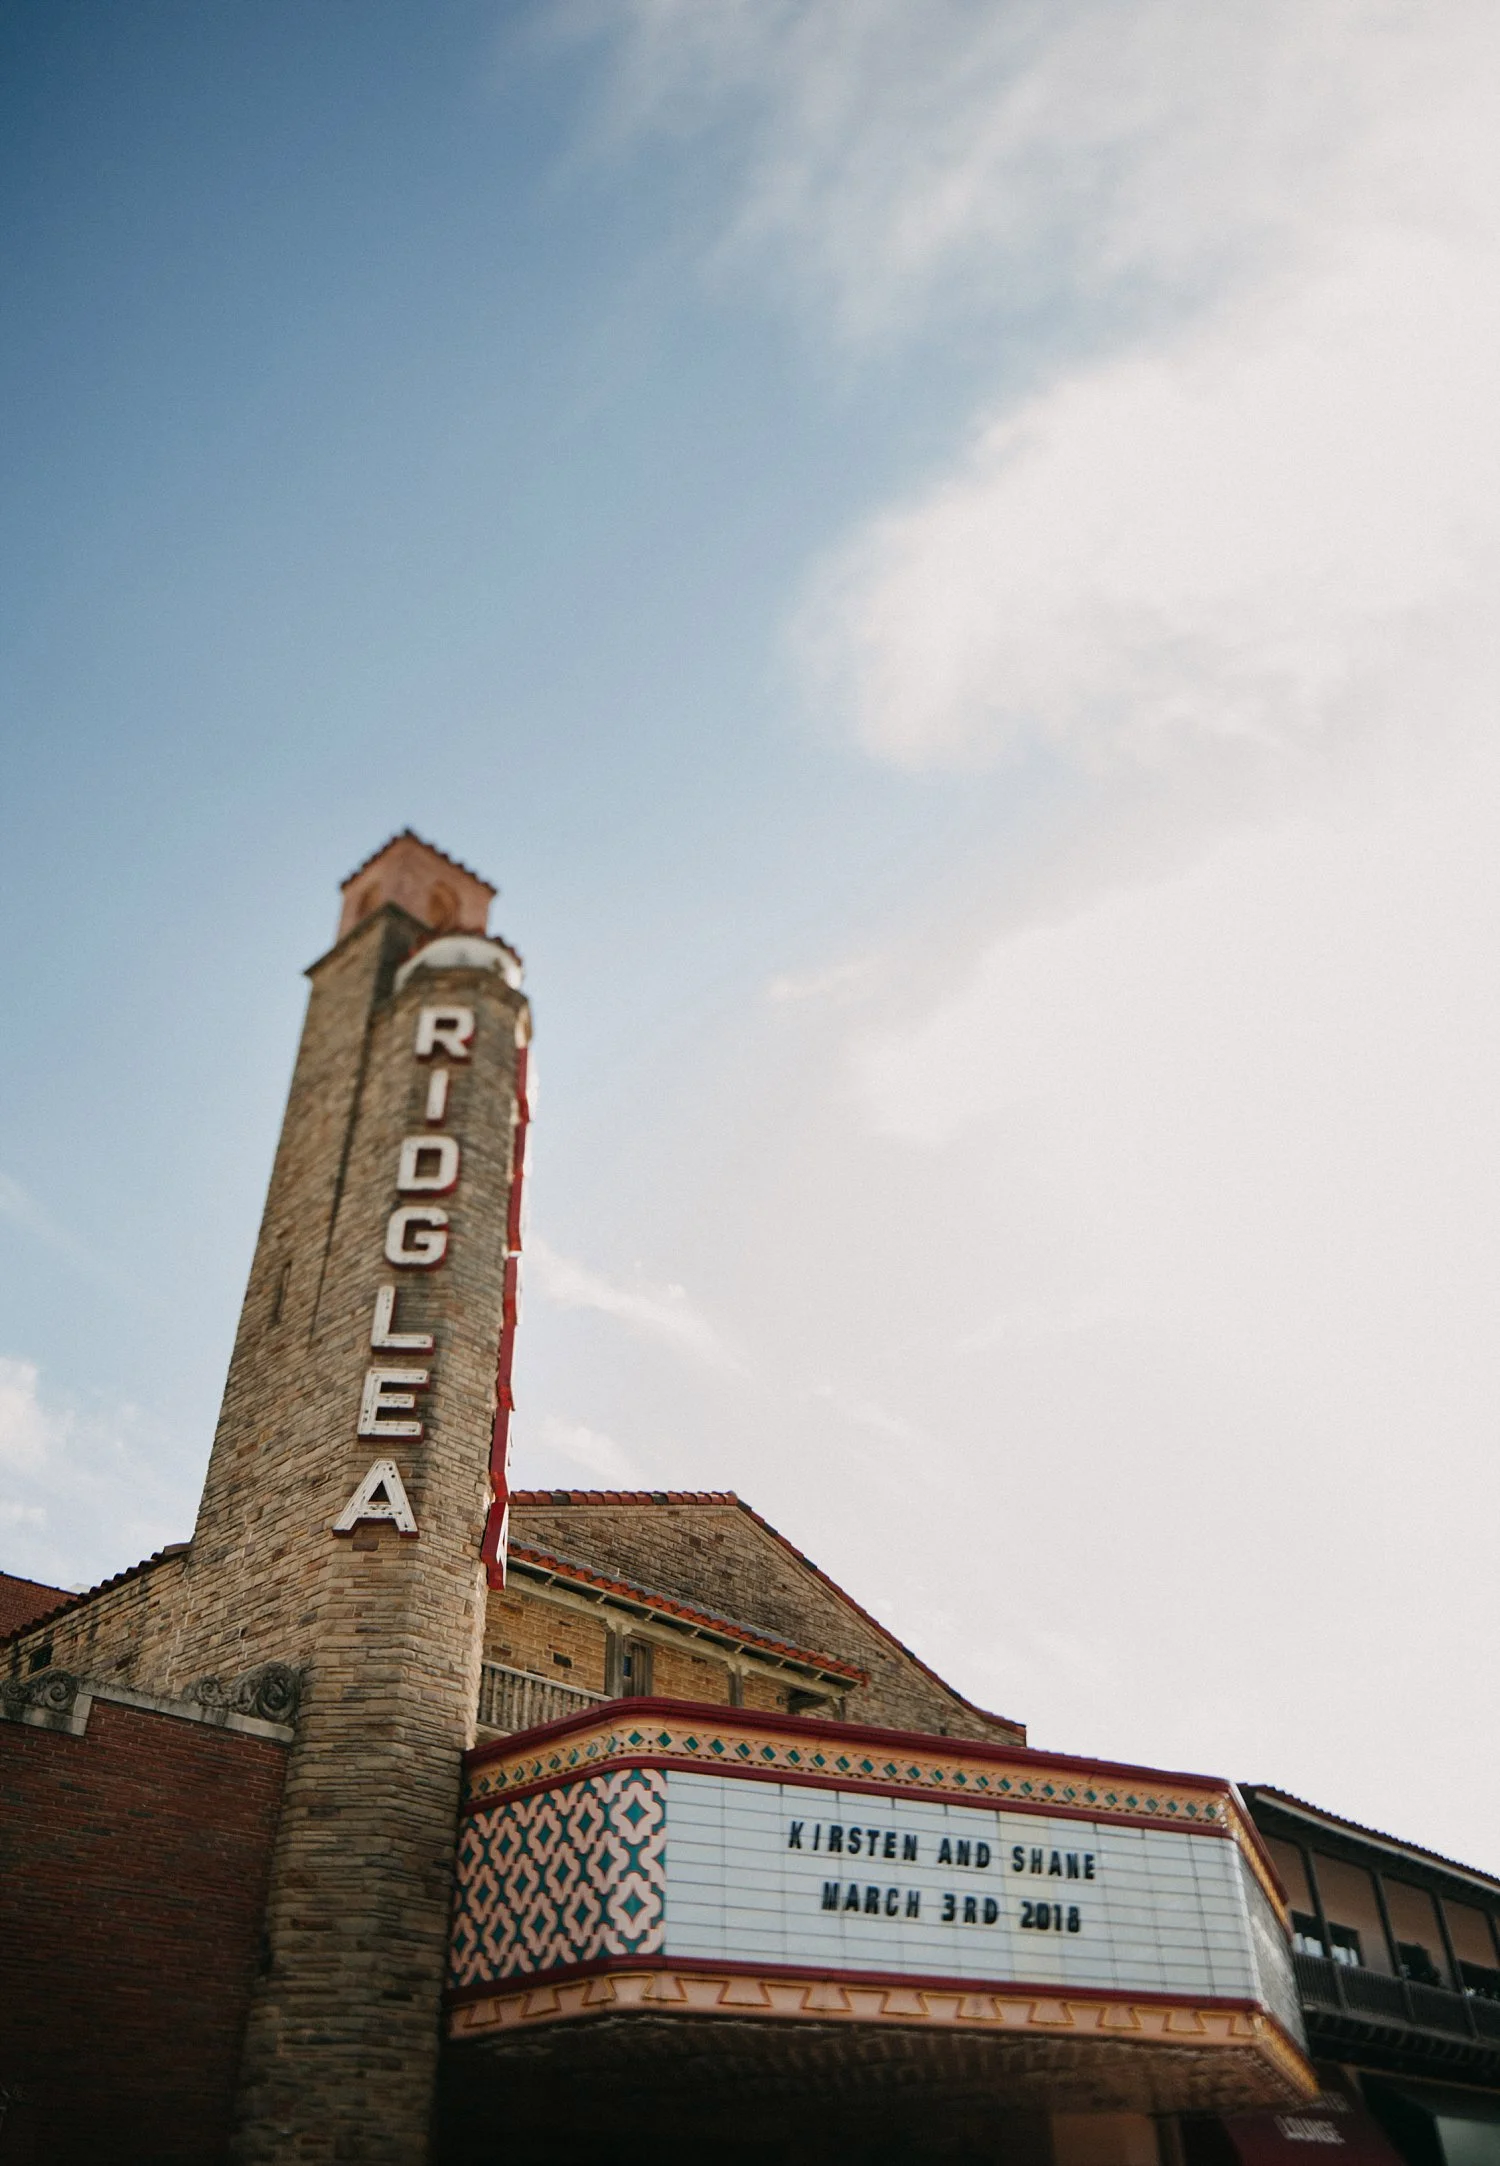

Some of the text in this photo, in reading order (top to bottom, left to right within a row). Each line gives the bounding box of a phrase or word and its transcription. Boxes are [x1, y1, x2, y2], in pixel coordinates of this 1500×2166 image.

[332, 1004, 476, 1539] RIDGLEA
[788, 1820, 1096, 1880] KIRSTEN AND SHANE
[821, 1881, 1081, 1933] MARCH 3RD 2018
